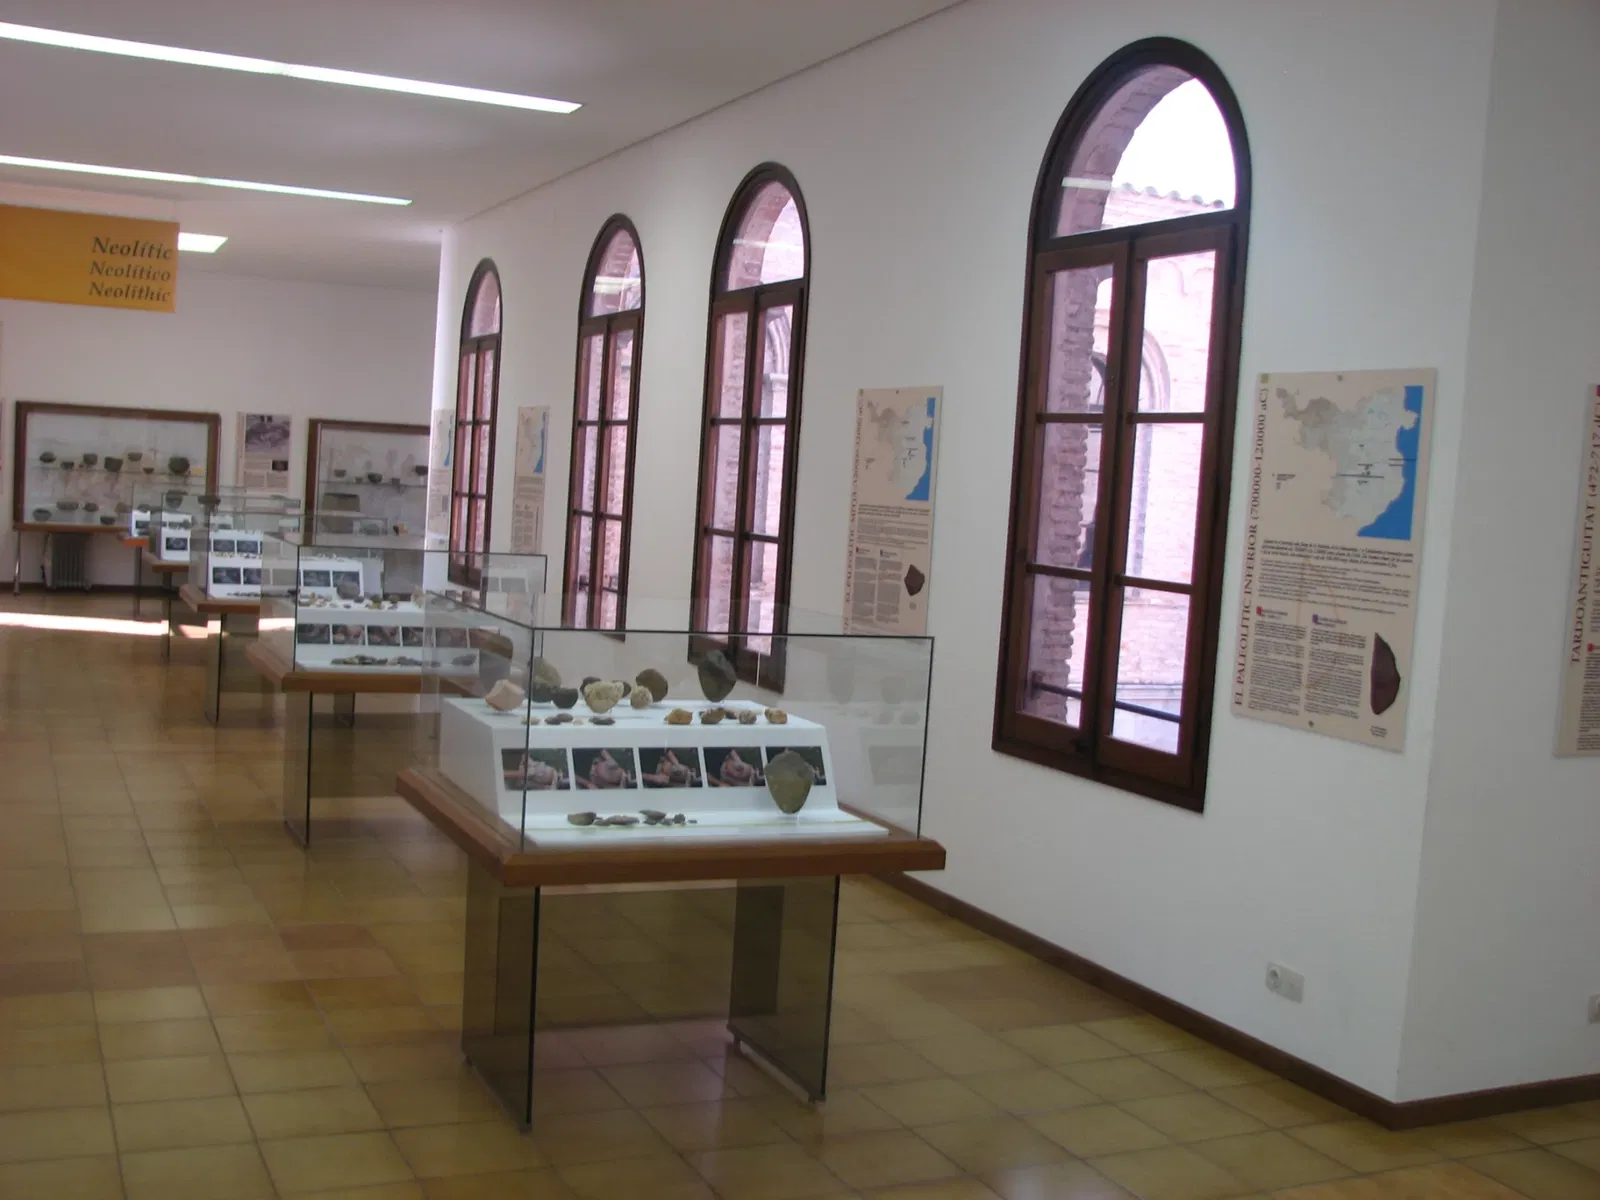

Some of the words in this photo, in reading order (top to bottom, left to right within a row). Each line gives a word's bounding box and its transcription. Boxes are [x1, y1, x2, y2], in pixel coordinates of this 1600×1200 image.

[88, 281, 171, 302] Neolithic
[1234, 689, 1244, 706] EL
[1244, 524, 1258, 595] INFERIOR
[1570, 501, 1596, 666] TARDOANTIGUITAT
